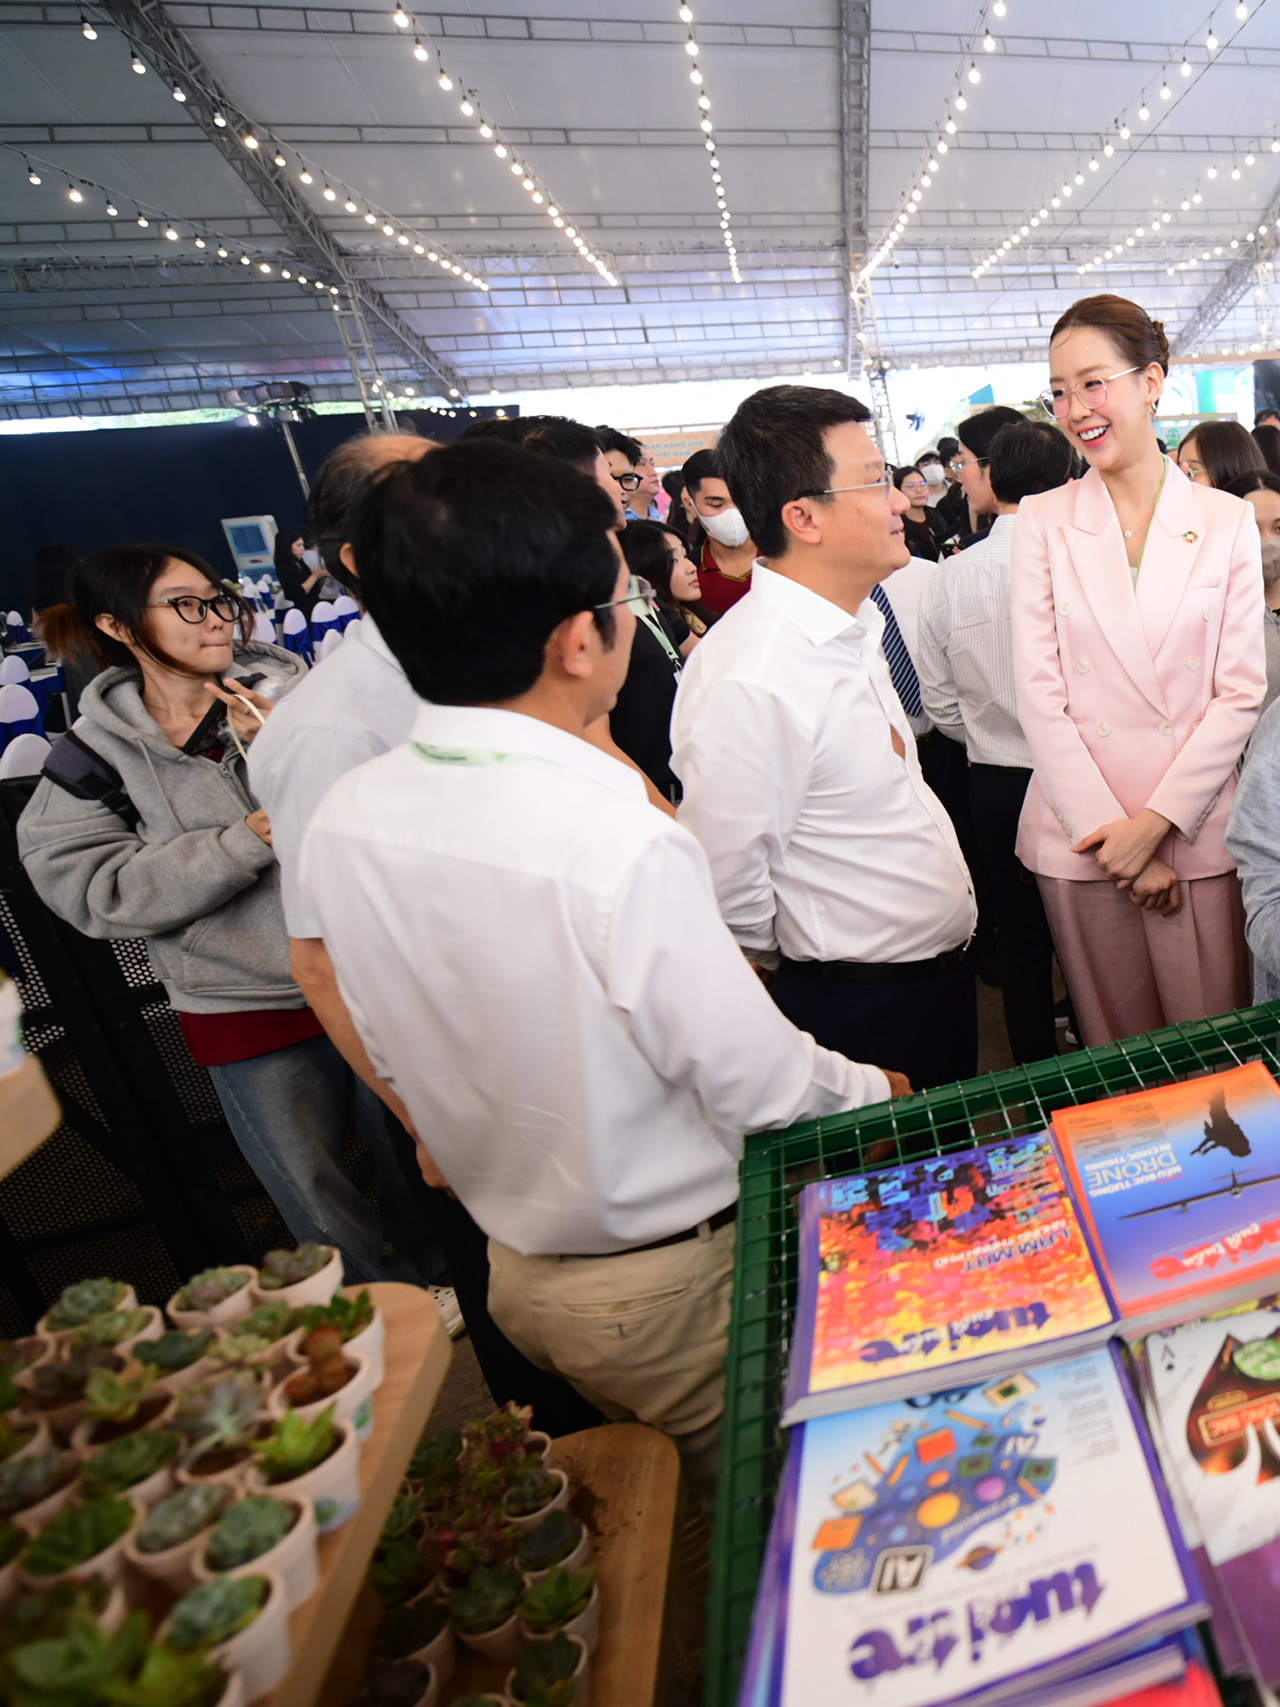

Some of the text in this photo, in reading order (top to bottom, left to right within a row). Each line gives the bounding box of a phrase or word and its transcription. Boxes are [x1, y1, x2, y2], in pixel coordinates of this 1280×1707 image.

[1084, 1151, 1178, 1189] DRONE
[1004, 1433, 1037, 1456] AI
[879, 1553, 925, 1586] AI
